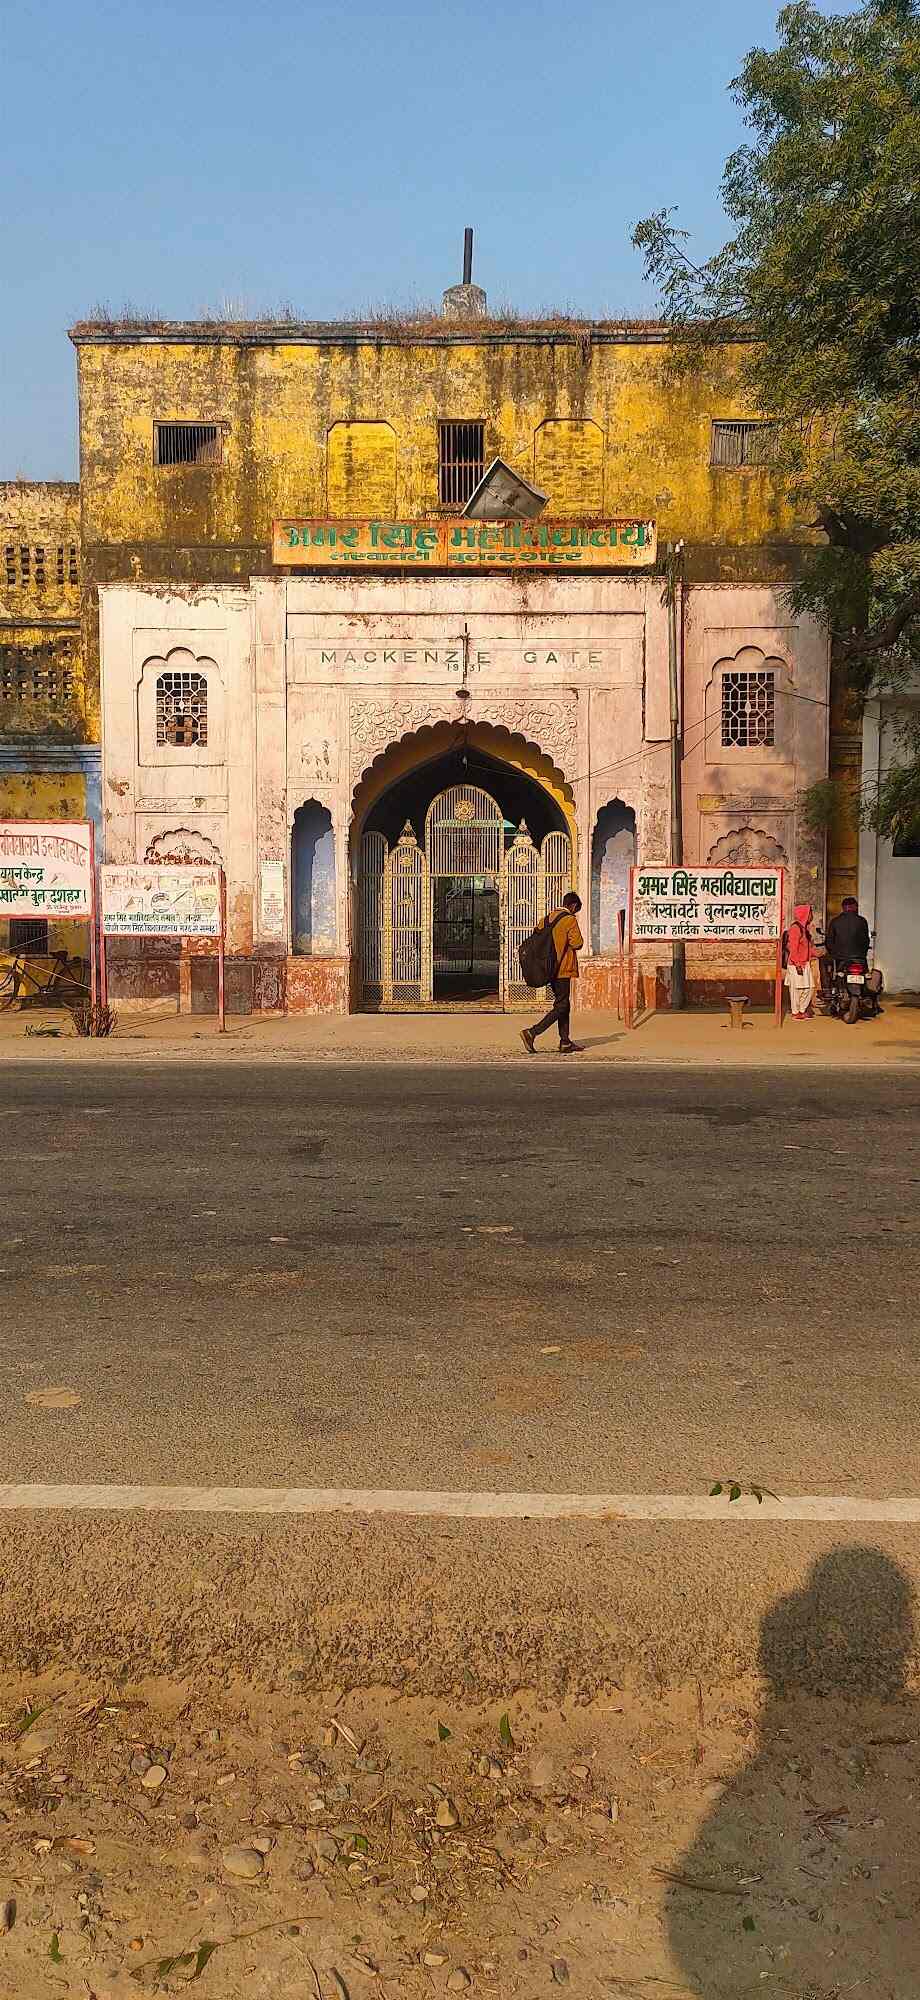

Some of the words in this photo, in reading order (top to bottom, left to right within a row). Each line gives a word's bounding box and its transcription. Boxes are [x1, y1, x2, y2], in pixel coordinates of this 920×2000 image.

[281, 526, 360, 548] अमर
[449, 524, 646, 548] महाविद्यालय
[321, 651, 491, 664] MACKENZE
[524, 651, 602, 664] GATE
[447, 663, 481, 672] 1931
[23, 862, 45, 884] केन्द्र
[638, 876, 670, 897] अमर
[672, 870, 699, 897] सिंह
[701, 871, 778, 898] महाविद्यालय
[648, 898, 699, 919] लखावटी
[704, 903, 769, 924] बुलन्दशहर
[635, 924, 667, 936] आपका
[671, 921, 700, 937] हार्दिक
[703, 925, 735, 936] स्वागत
[738, 925, 764, 936] करता
